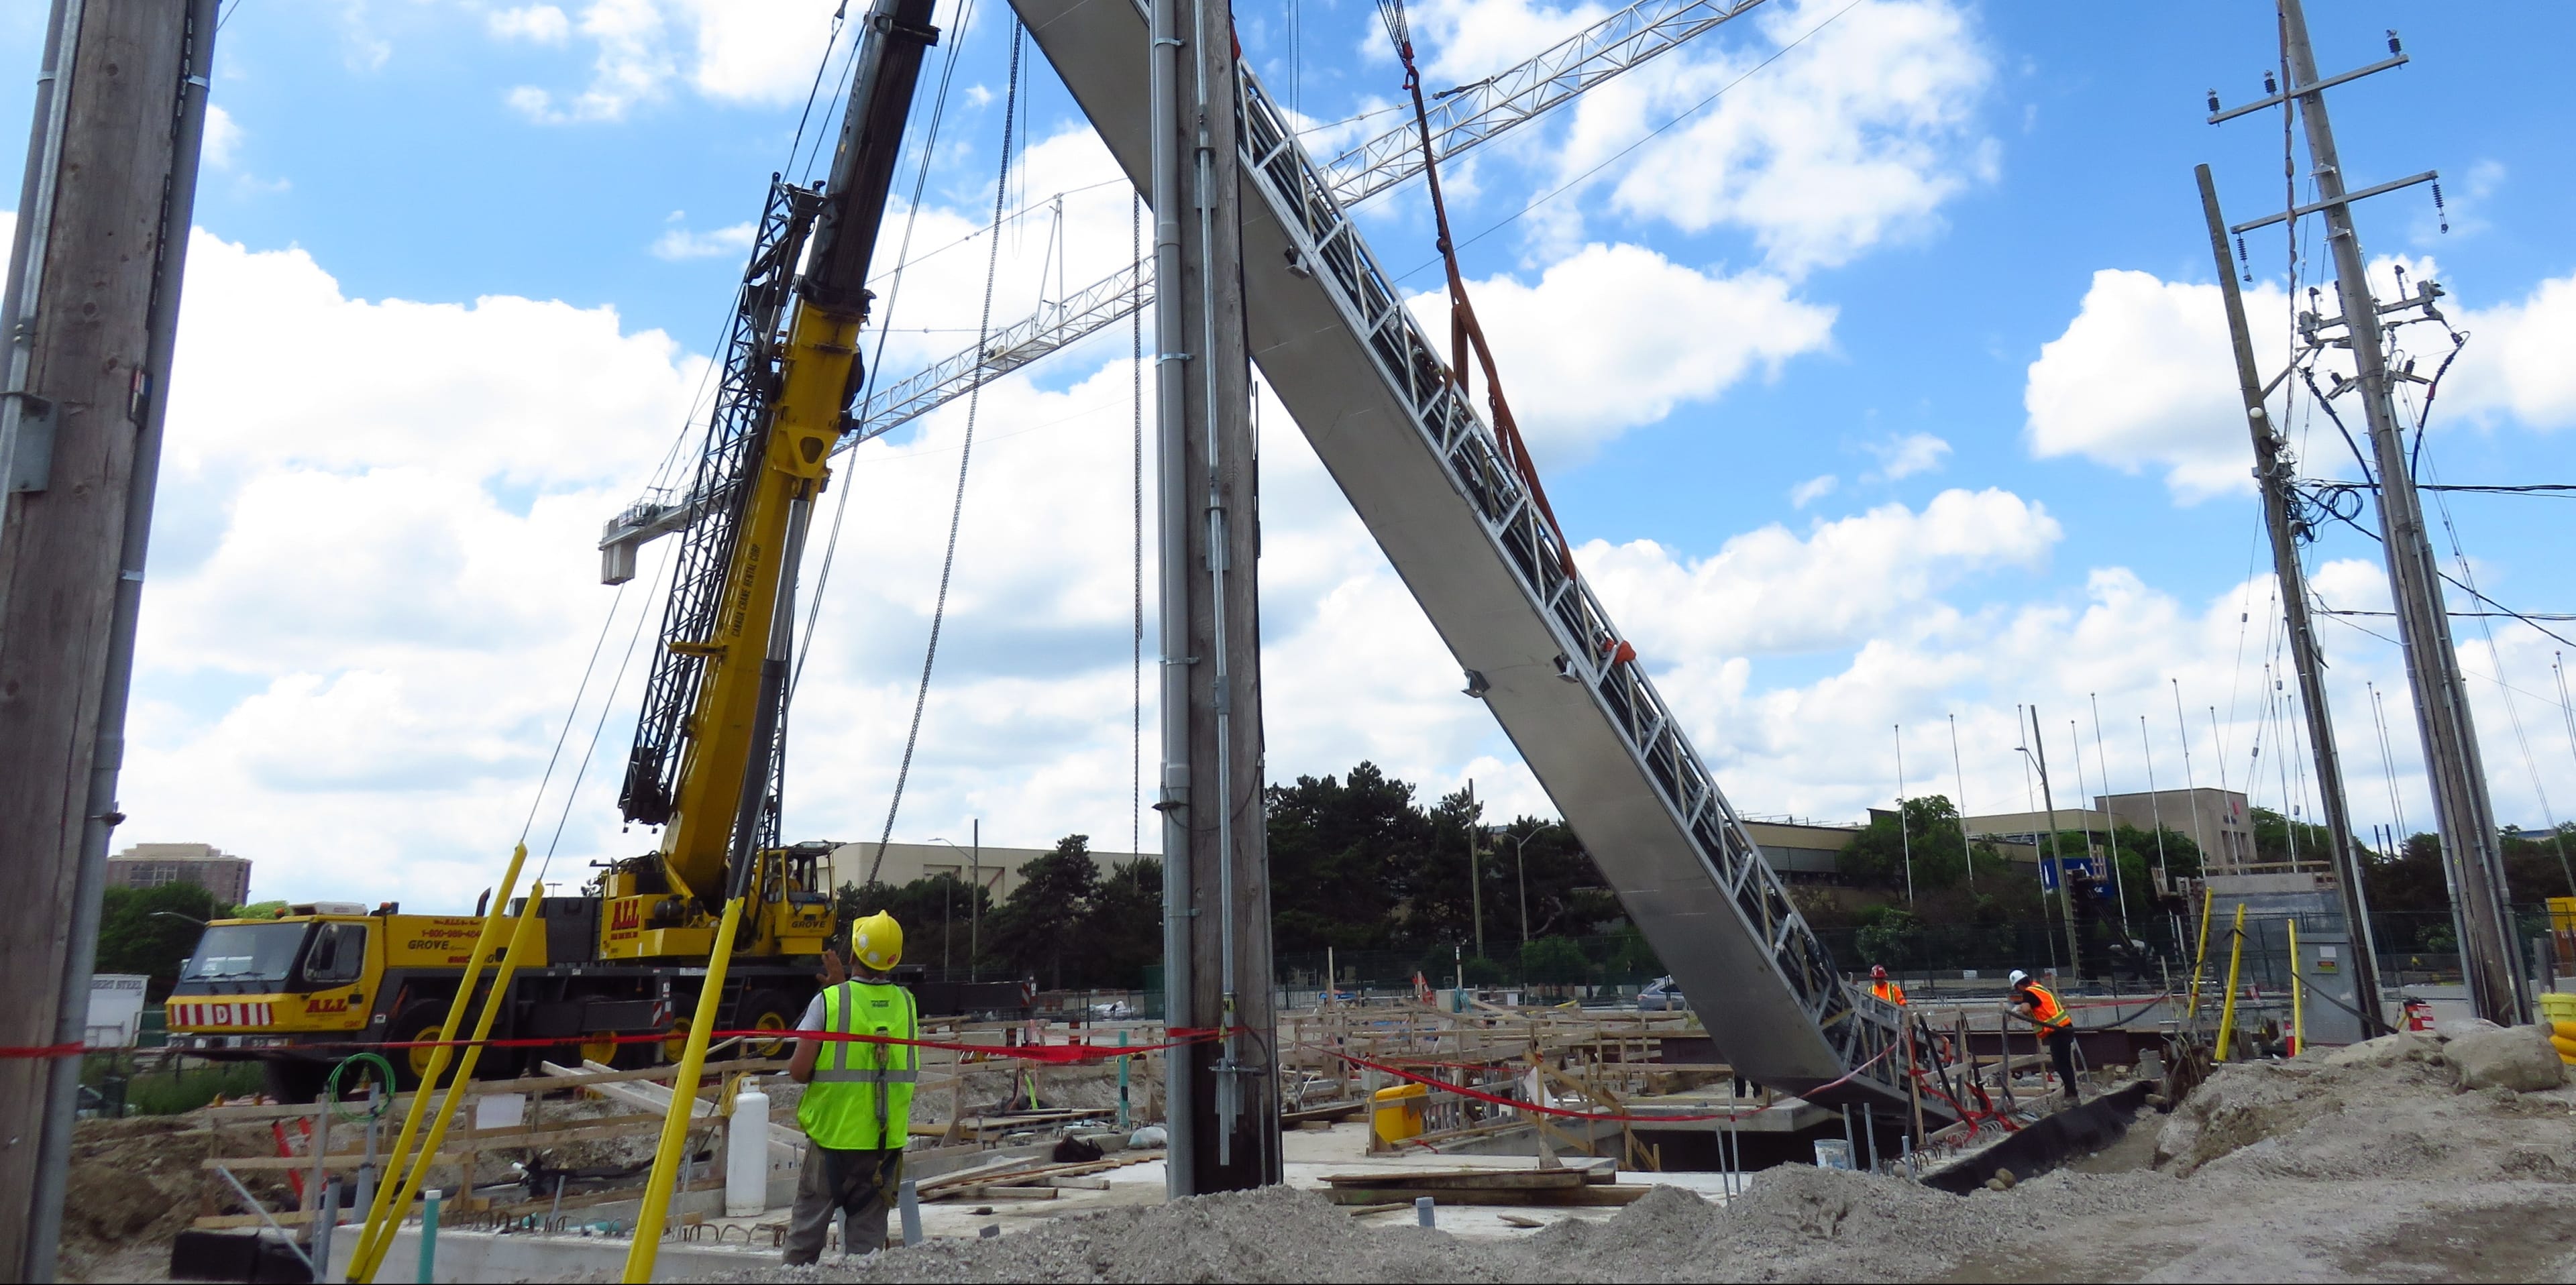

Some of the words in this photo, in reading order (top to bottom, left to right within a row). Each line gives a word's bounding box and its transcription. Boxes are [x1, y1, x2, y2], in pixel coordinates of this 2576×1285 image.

[749, 543, 761, 562] CORP
[743, 564, 757, 588] RENTAL
[738, 588, 751, 610] CRANE
[731, 612, 745, 637] CANADA
[611, 899, 640, 931] ALL
[792, 920, 826, 929] GROVE
[408, 940, 449, 950] GROVE
[215, 1005, 228, 1023] D
[305, 999, 347, 1013] ALL
